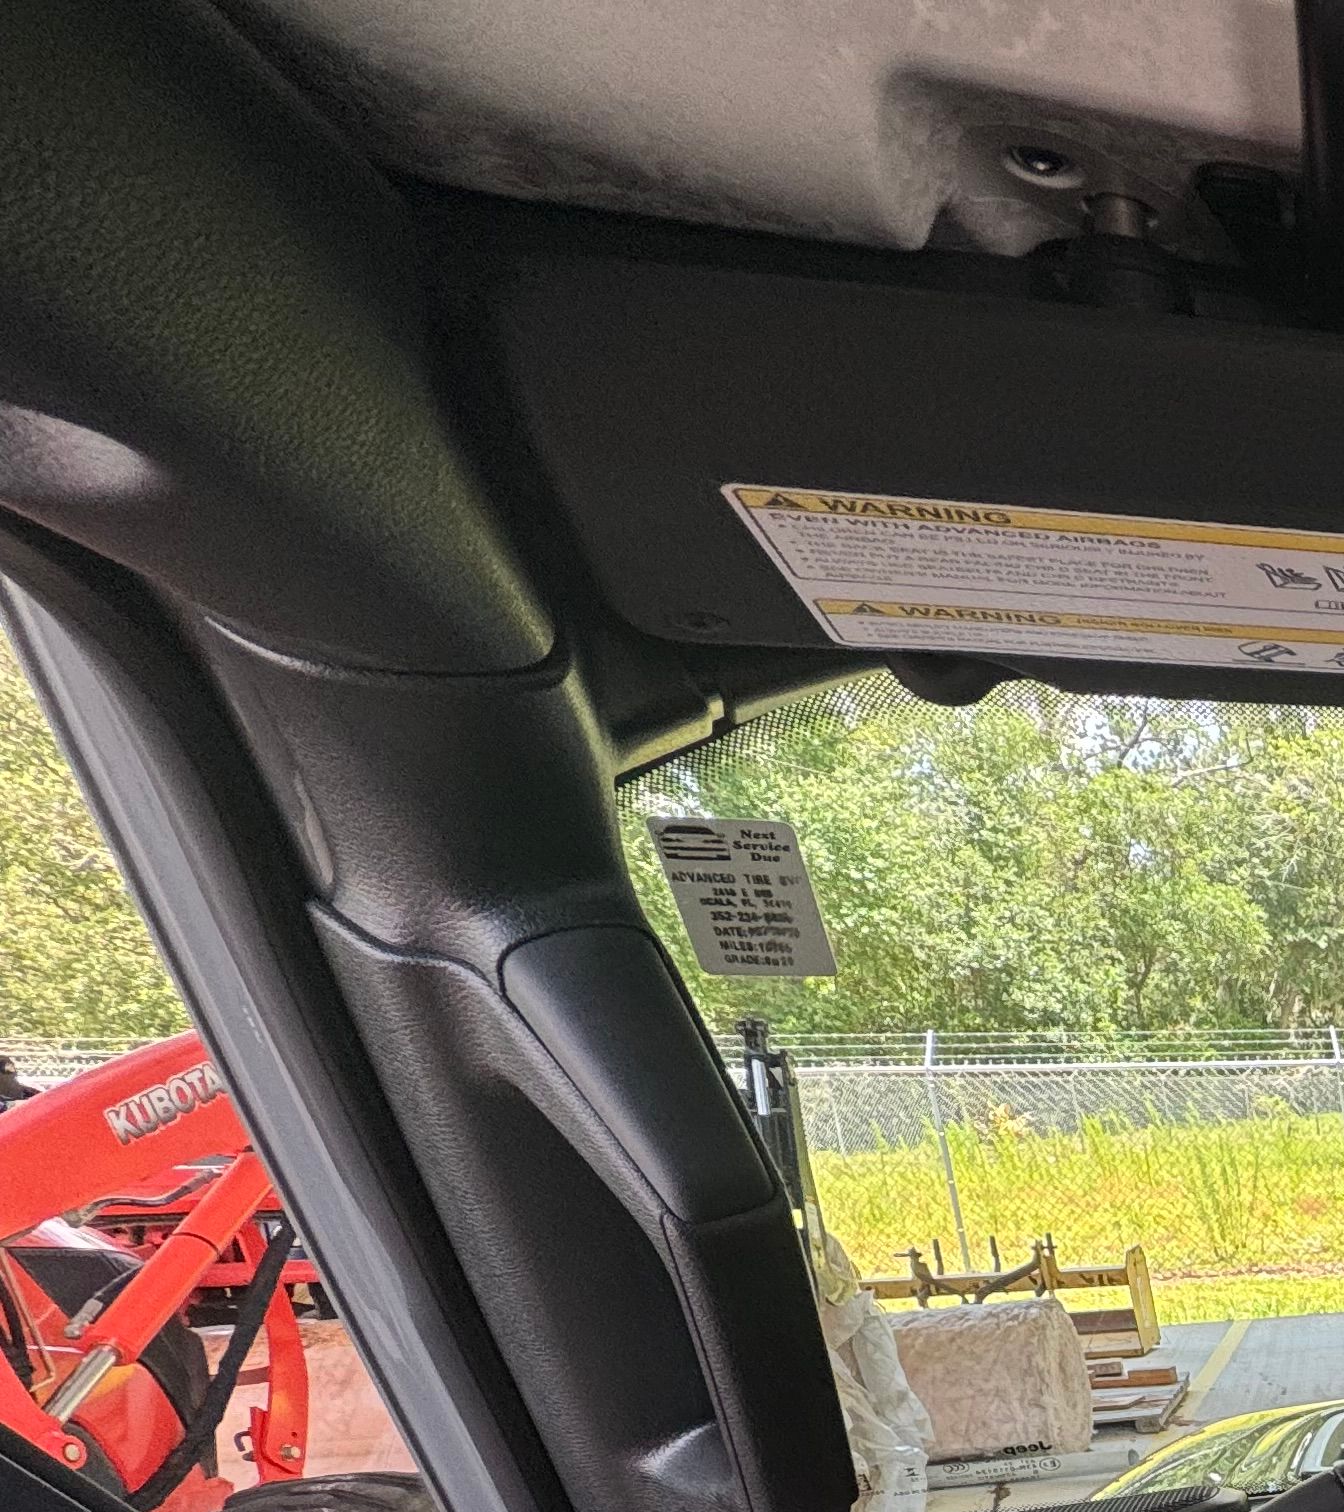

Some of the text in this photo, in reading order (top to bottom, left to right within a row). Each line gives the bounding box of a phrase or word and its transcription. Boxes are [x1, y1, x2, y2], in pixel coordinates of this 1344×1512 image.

[819, 498, 1012, 524] WARNING
[769, 512, 1161, 549] EVEN WITH ADVANCED AIRBAGS
[898, 606, 1062, 625] WARNING
[740, 829, 776, 840] Next
[732, 840, 791, 852] Service
[750, 852, 781, 862] Due
[671, 871, 772, 885] ADVANCED TIRE
[105, 1063, 229, 1146] KUBOTA
